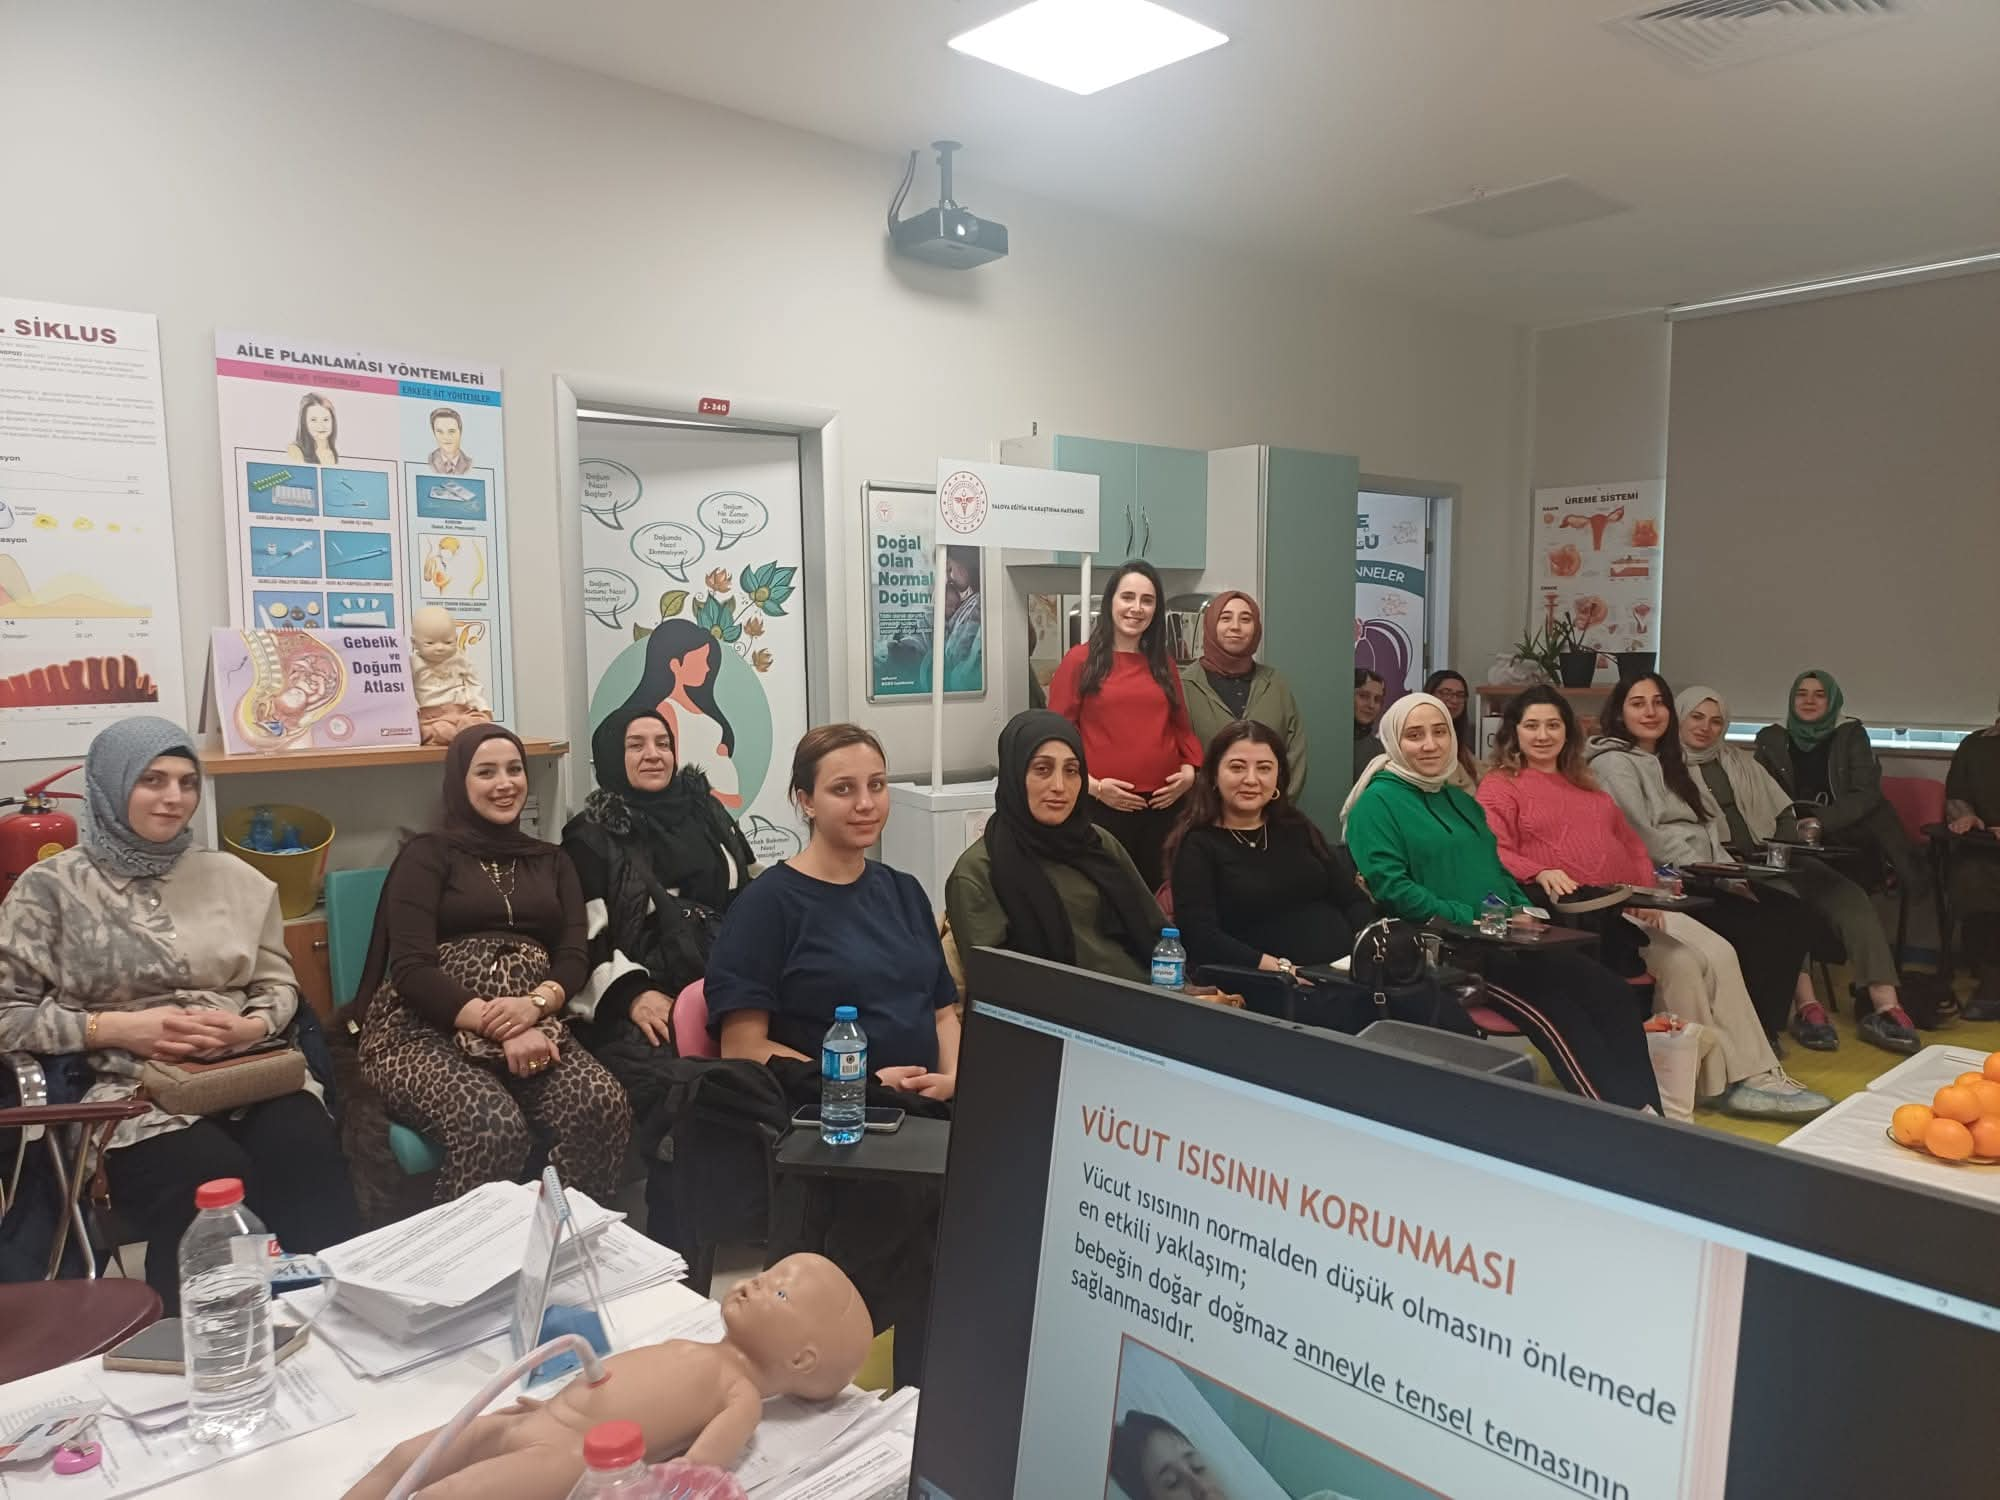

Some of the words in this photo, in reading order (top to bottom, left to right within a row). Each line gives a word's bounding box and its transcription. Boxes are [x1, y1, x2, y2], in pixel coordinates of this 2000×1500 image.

[14, 316, 117, 345] SİKLUS
[237, 342, 275, 360] AİLE
[280, 350, 383, 374] PLANLAMASI
[388, 362, 485, 385] YÖNTEMLERİ
[1564, 495, 1598, 505] ÜREME
[1600, 492, 1639, 503] SİSTEMİ
[877, 534, 921, 553] Doğal
[877, 552, 914, 568] Olan
[878, 571, 934, 586] Normal
[343, 636, 399, 649] Gebelik
[352, 661, 402, 677] Doğum
[363, 680, 405, 694] Atlası
[1081, 1104, 1171, 1163] VÜCUT
[1177, 1141, 1289, 1211] ISISININ
[1299, 1183, 1516, 1295] KORUNMASI
[1079, 1200, 1099, 1222] en
[1104, 1211, 1151, 1245] etkili
[1155, 1231, 1248, 1290] yaklaşım;
[1083, 1161, 1132, 1202] Vücut
[1136, 1189, 1200, 1230] ısısının
[1206, 1217, 1318, 1278] normalden
[1326, 1264, 1395, 1310] düşük
[1402, 1293, 1512, 1359] olmasını
[1522, 1338, 1678, 1425] önlemede
[1071, 1268, 1195, 1343] sağlanmasıdır.
[1074, 1231, 1143, 1282] bebeğin
[1148, 1267, 1203, 1308] doğar
[1207, 1294, 1289, 1350] doğmaz
[1294, 1337, 1387, 1394] anneyle
[1395, 1378, 1473, 1437] tensel
[1485, 1419, 1630, 1500] temasının
